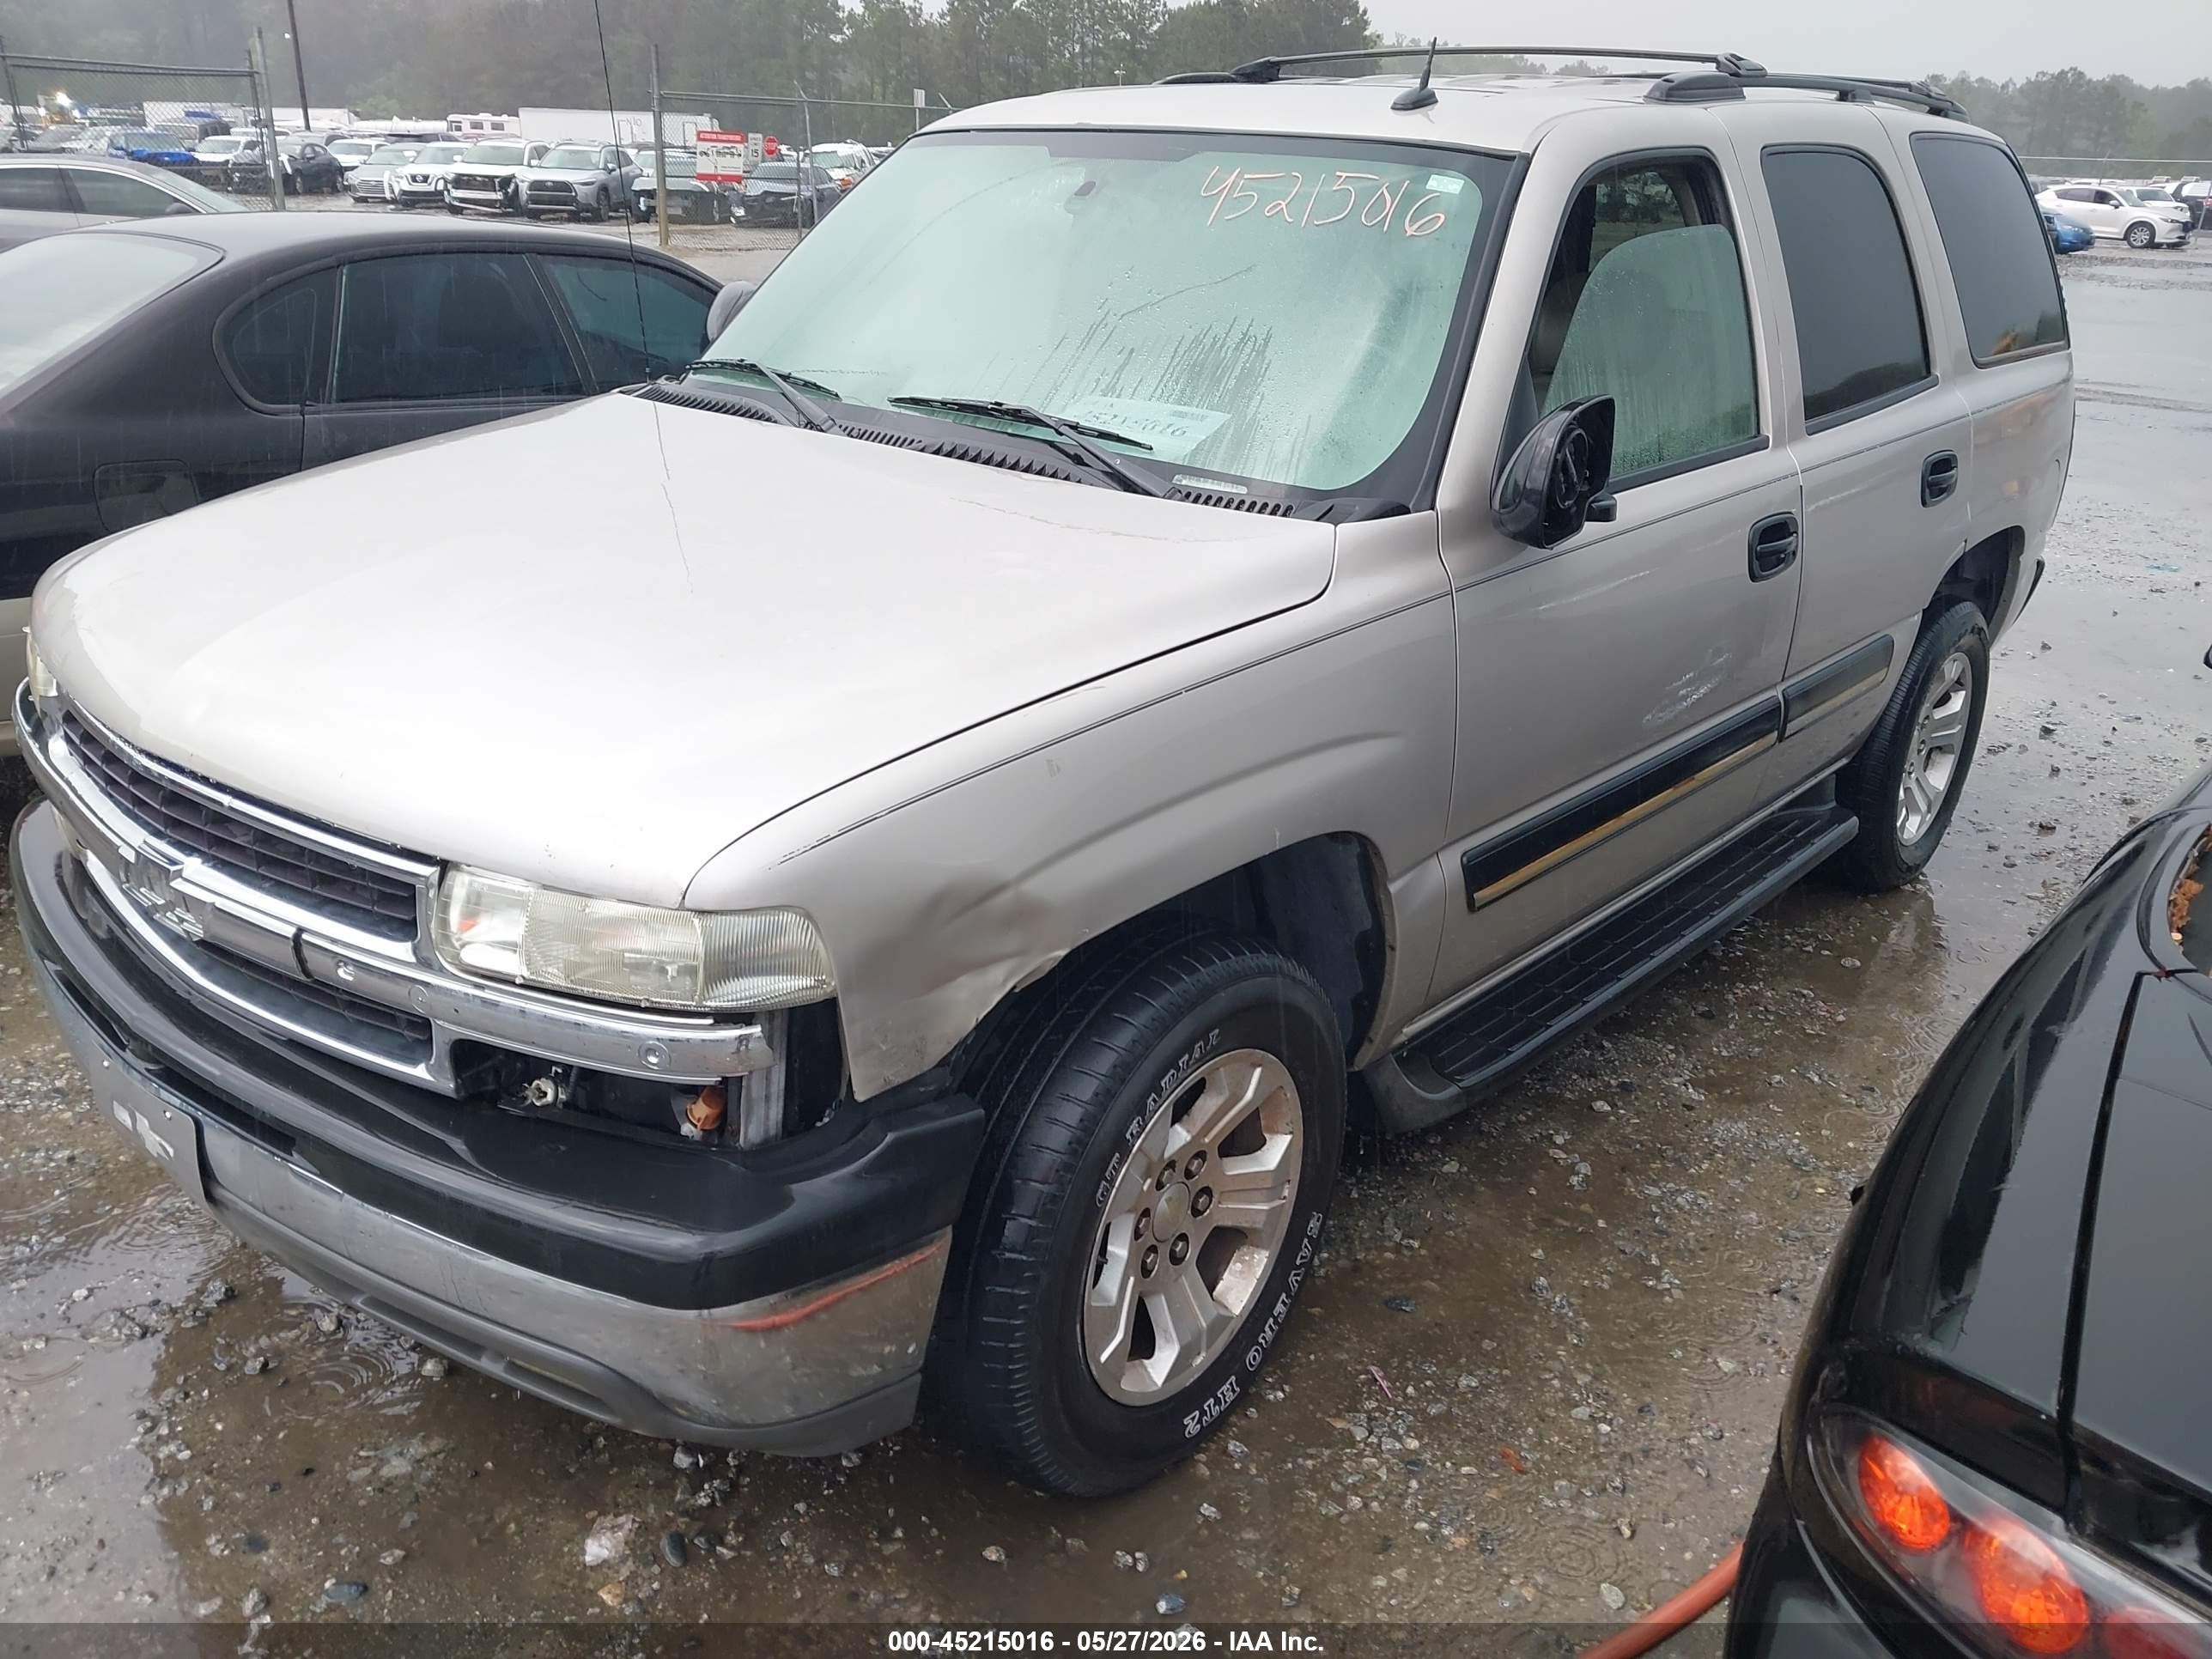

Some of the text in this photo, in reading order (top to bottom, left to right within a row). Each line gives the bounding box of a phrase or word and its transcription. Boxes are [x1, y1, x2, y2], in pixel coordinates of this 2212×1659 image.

[750, 149, 759, 158] 15
[1200, 166, 1445, 237] 45215016
[1096, 1028, 1220, 1207] GT RADIAL
[1183, 1212, 1322, 1438] SAVERO HT2
